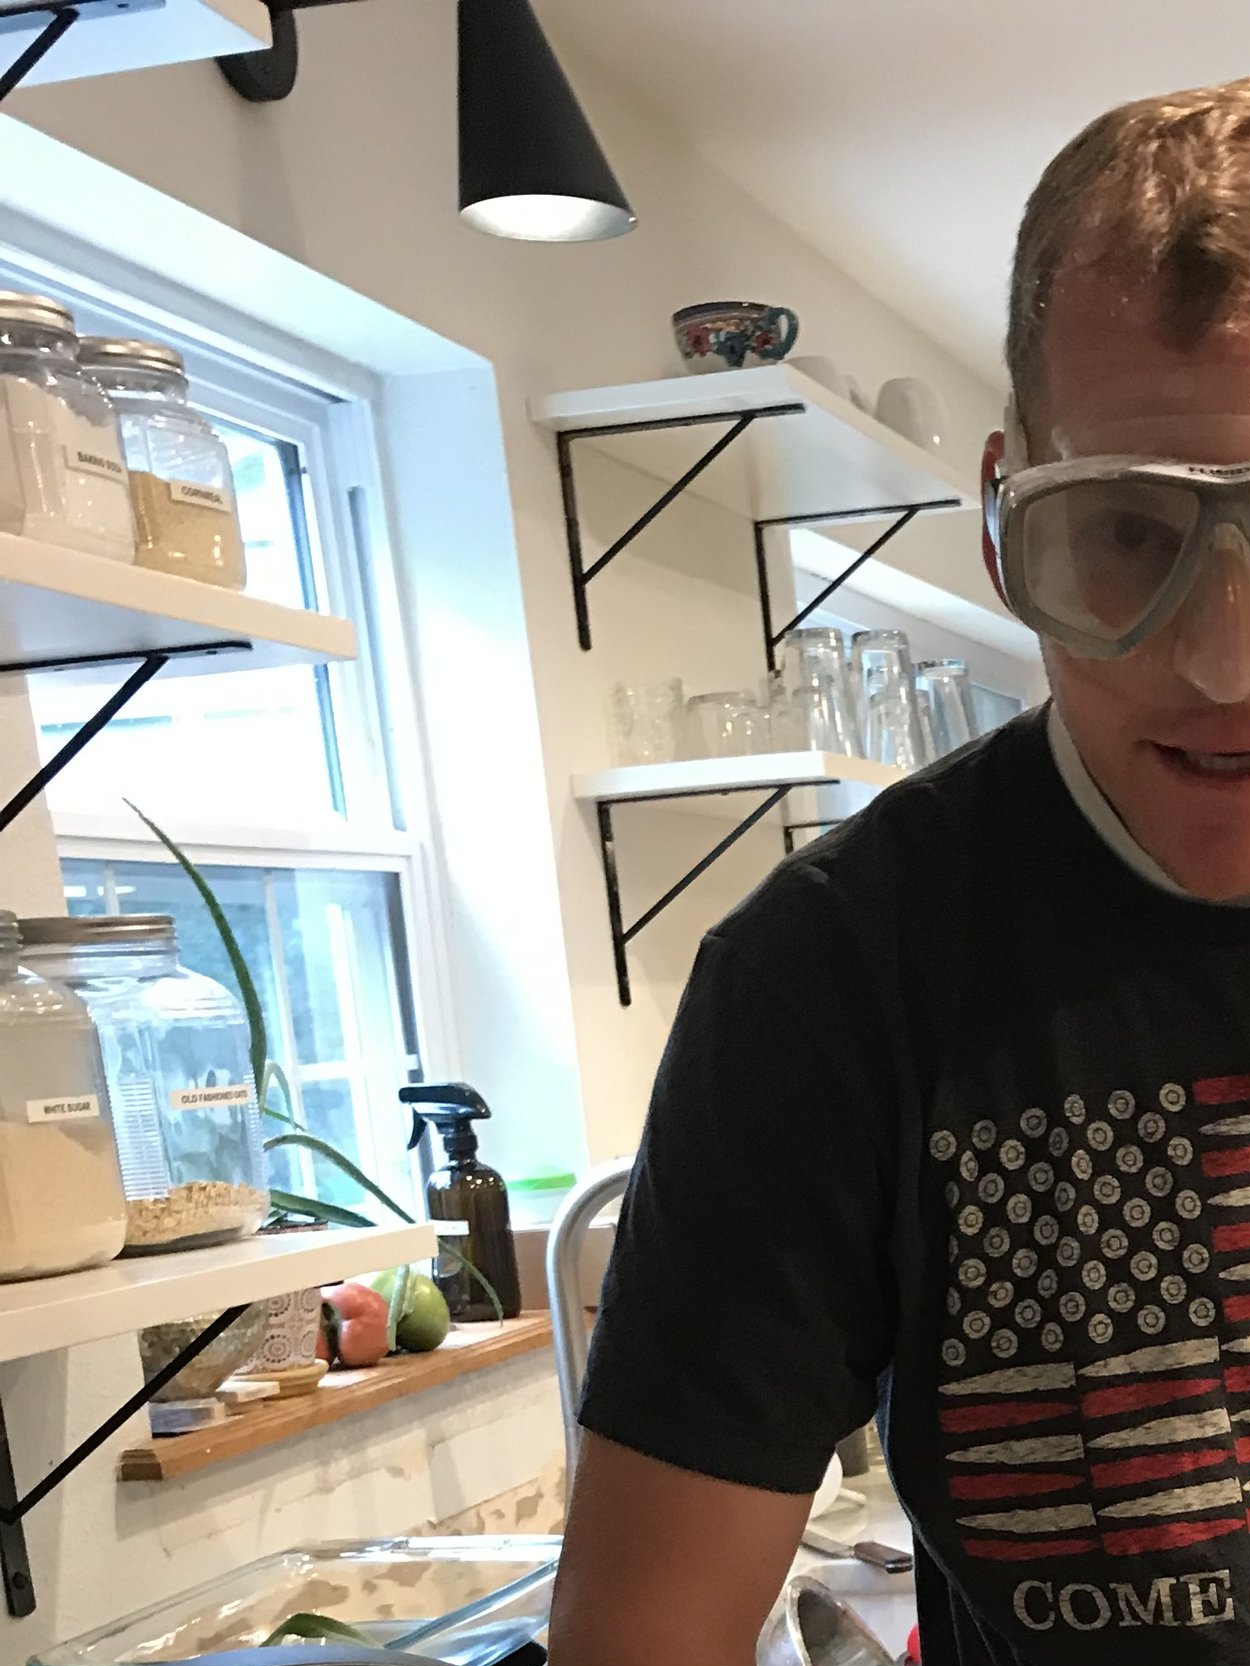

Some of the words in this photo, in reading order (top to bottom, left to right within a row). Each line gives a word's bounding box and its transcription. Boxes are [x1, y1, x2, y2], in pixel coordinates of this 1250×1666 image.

[181, 1094, 198, 1104] OLD
[43, 1103, 66, 1115] WHITE
[67, 1102, 91, 1112] SUGAR
[1013, 1569, 1236, 1631] COME
